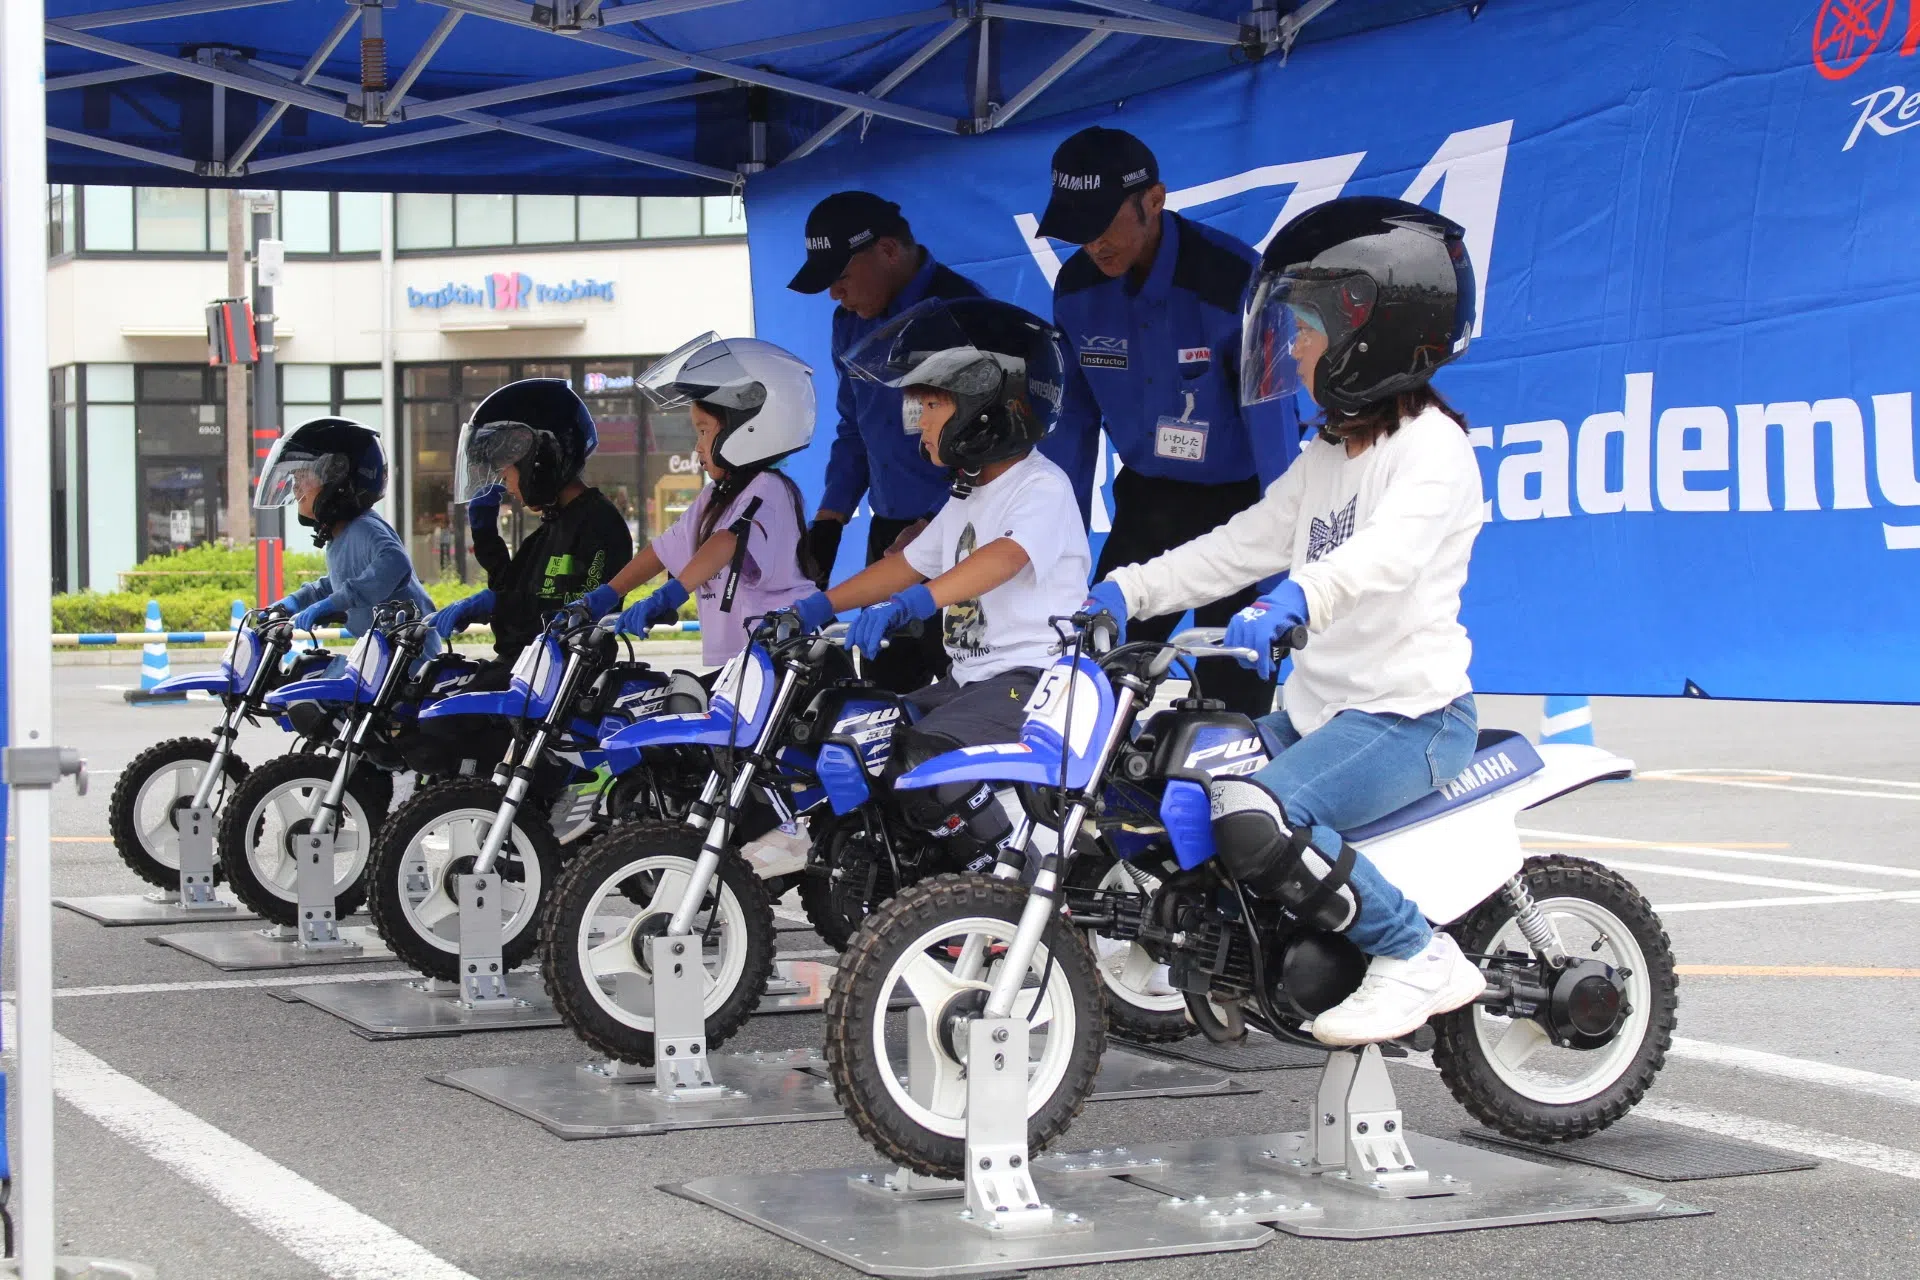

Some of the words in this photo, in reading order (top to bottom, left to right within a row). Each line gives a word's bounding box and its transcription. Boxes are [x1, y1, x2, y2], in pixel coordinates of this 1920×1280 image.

[1058, 172, 1101, 191] YAMAHA
[407, 282, 483, 309] baskin
[536, 279, 616, 303] robbins
[1083, 356, 1126, 366] Instructor
[199, 426, 221, 435] 6900
[1163, 433, 1200, 447] いわした
[668, 451, 701, 474] Caf
[1033, 675, 1059, 710] 5
[831, 707, 901, 734] PW
[1183, 736, 1262, 769] PW
[1440, 751, 1519, 801] YAMAHA
